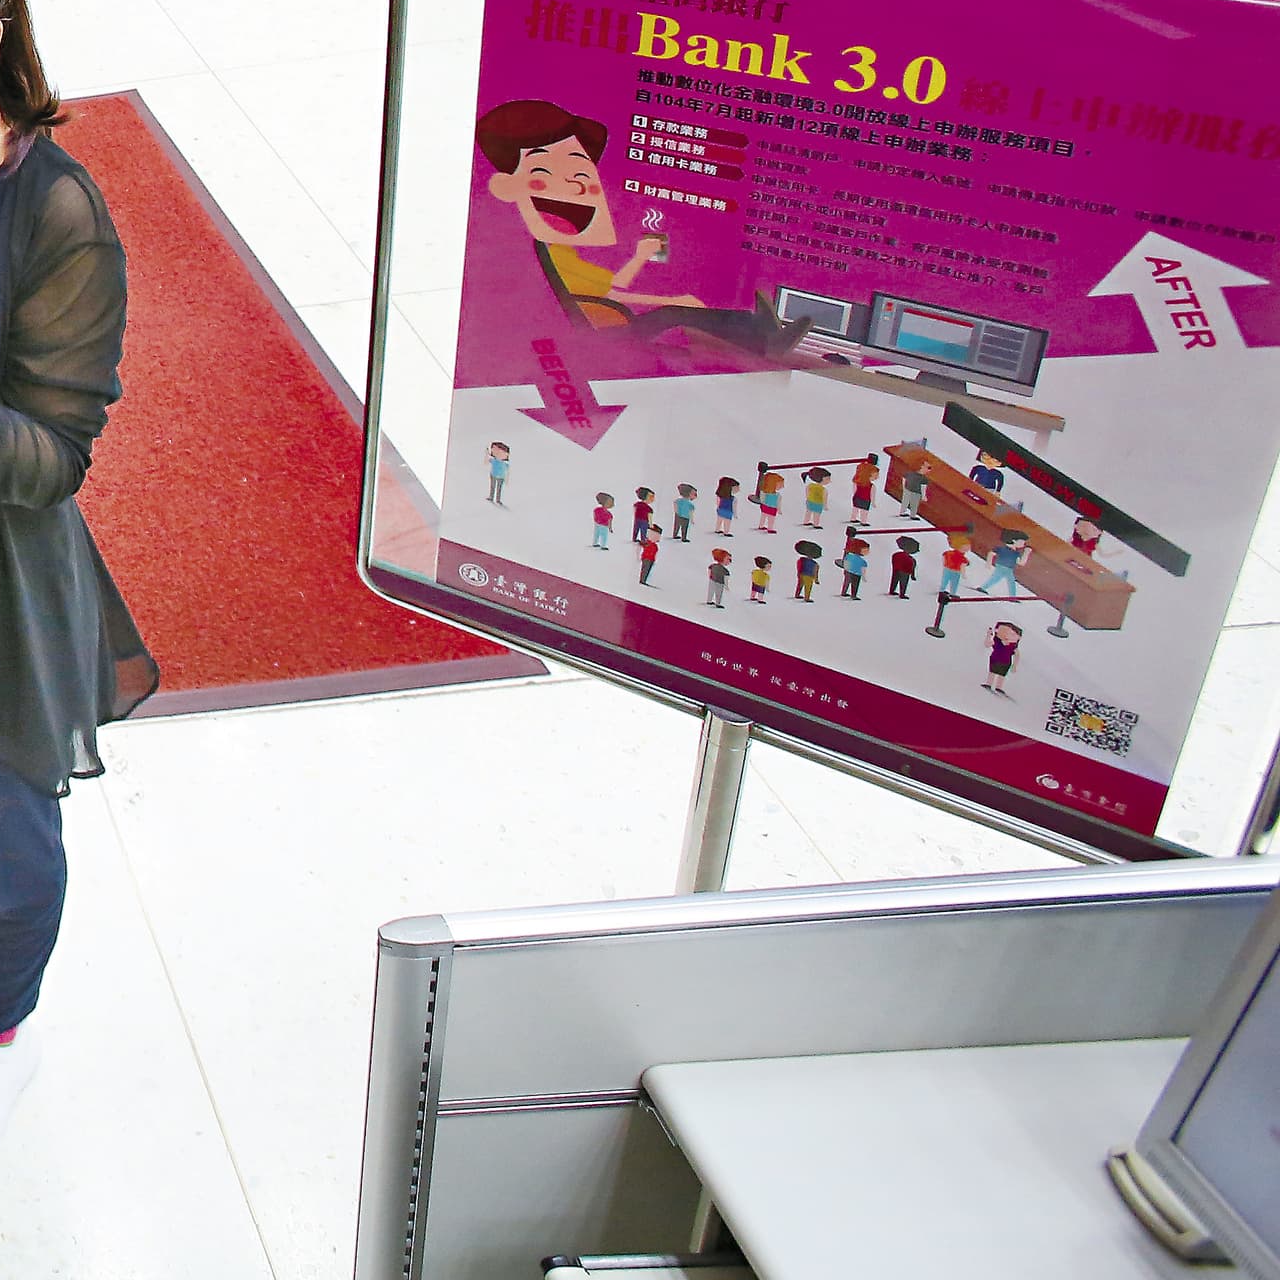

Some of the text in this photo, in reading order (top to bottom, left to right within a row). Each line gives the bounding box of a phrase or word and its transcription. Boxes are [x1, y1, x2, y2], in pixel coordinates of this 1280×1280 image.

[632, 11, 813, 85] Bank
[833, 44, 948, 106] 3.0
[651, 119, 709, 140] 存款業務
[649, 136, 706, 157] 授信業務
[647, 153, 718, 177] 信用卡業務
[643, 185, 728, 213] 財富管理業務
[1143, 255, 1218, 352] AFTER
[529, 337, 594, 433] BEFORE
